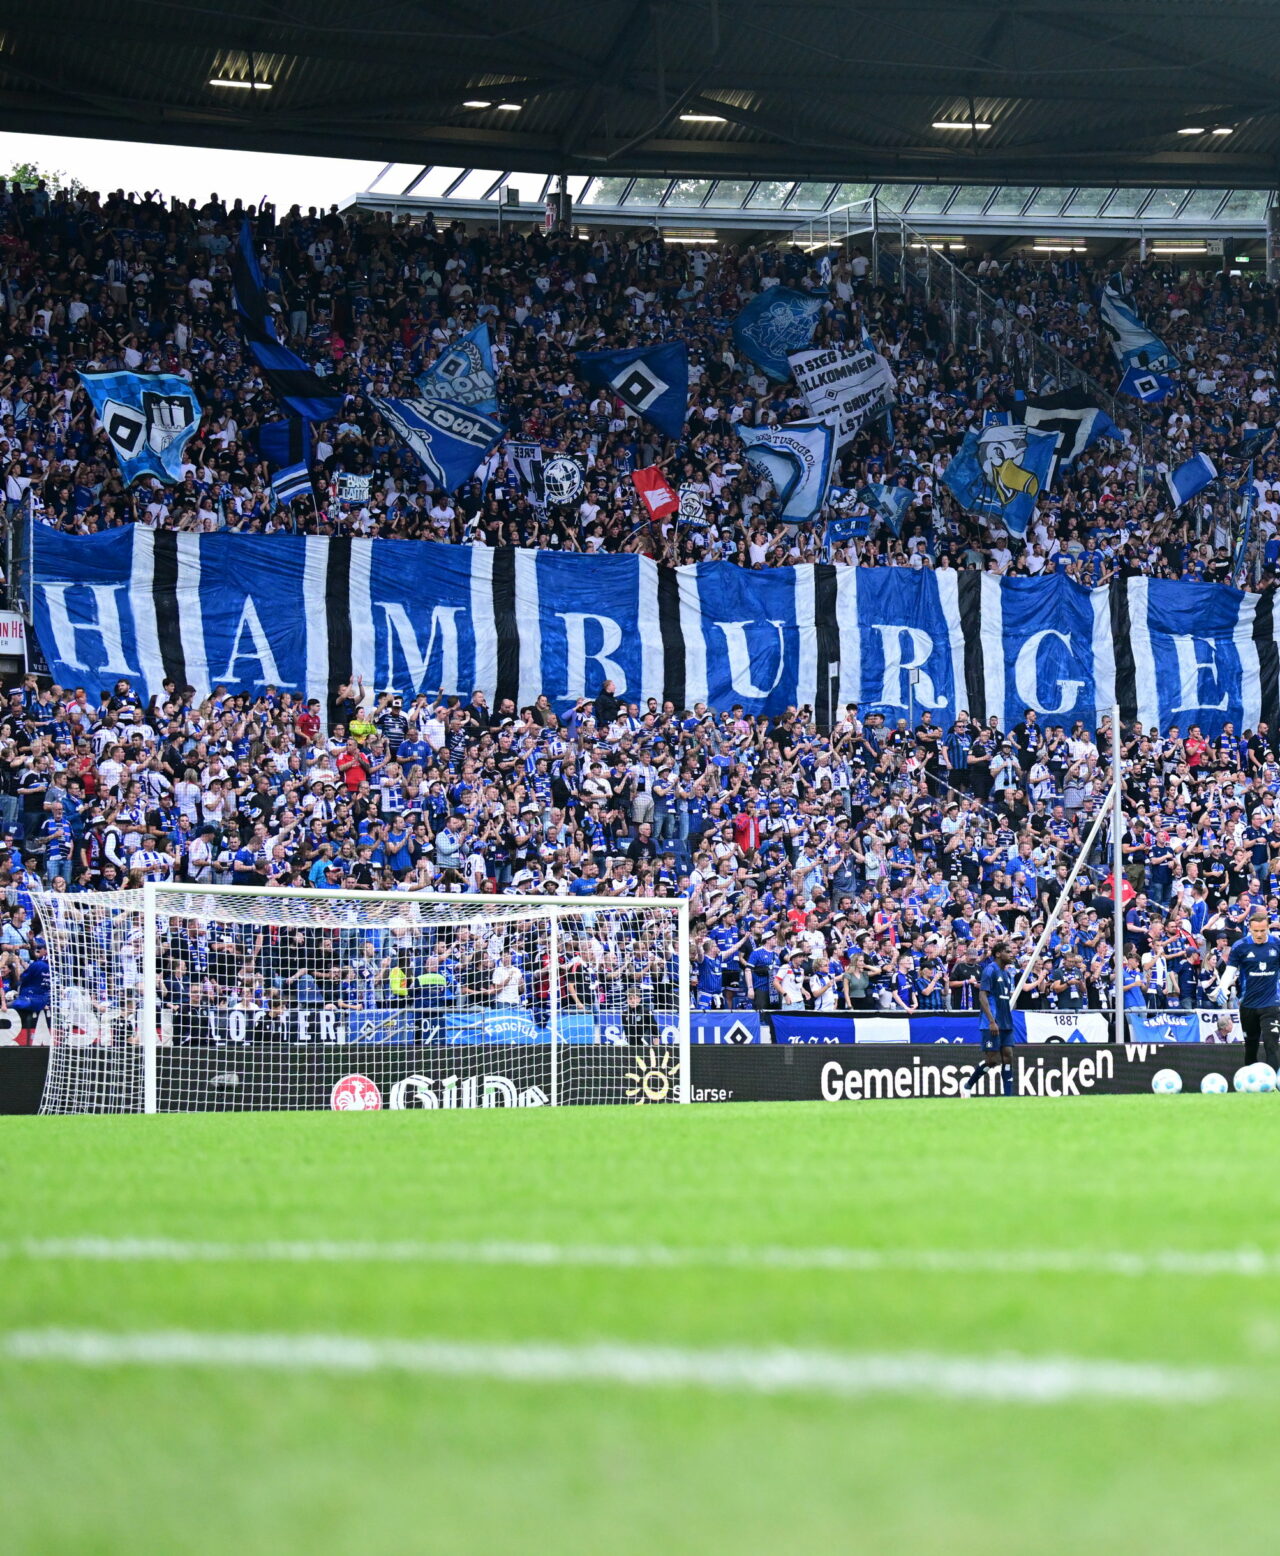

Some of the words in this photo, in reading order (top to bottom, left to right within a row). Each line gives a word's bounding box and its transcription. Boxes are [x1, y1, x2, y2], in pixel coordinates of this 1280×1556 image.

[804, 350, 838, 373] SIEG
[484, 1019, 539, 1040] Fanclub
[1053, 1015, 1079, 1026] 1887
[1017, 1049, 1114, 1097] kicken
[673, 1084, 733, 1102] Slarser
